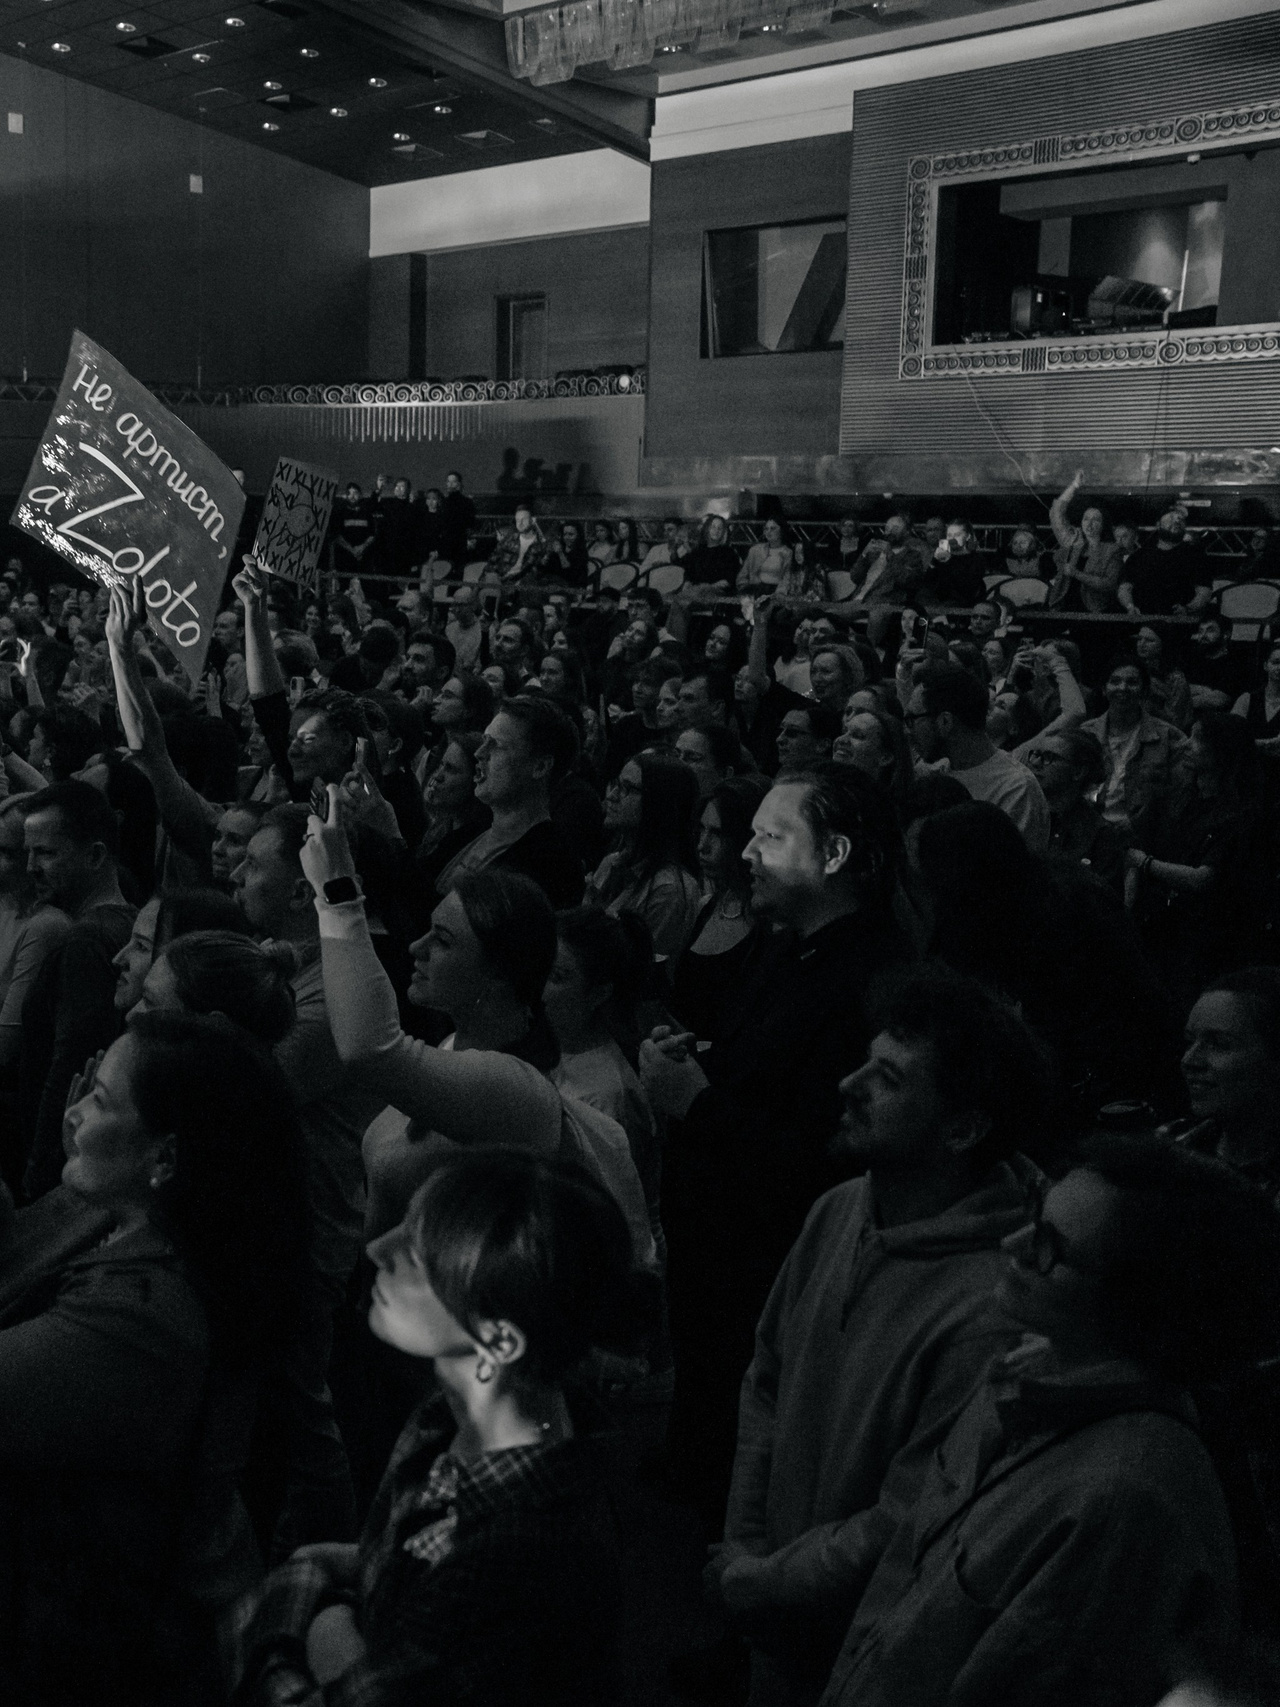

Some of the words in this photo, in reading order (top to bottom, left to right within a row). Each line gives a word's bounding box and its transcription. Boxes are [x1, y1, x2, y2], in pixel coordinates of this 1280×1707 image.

[28, 485, 66, 516] а
[56, 441, 200, 647] Zoloto
[72, 364, 113, 411] Не
[116, 412, 227, 559] артист,
